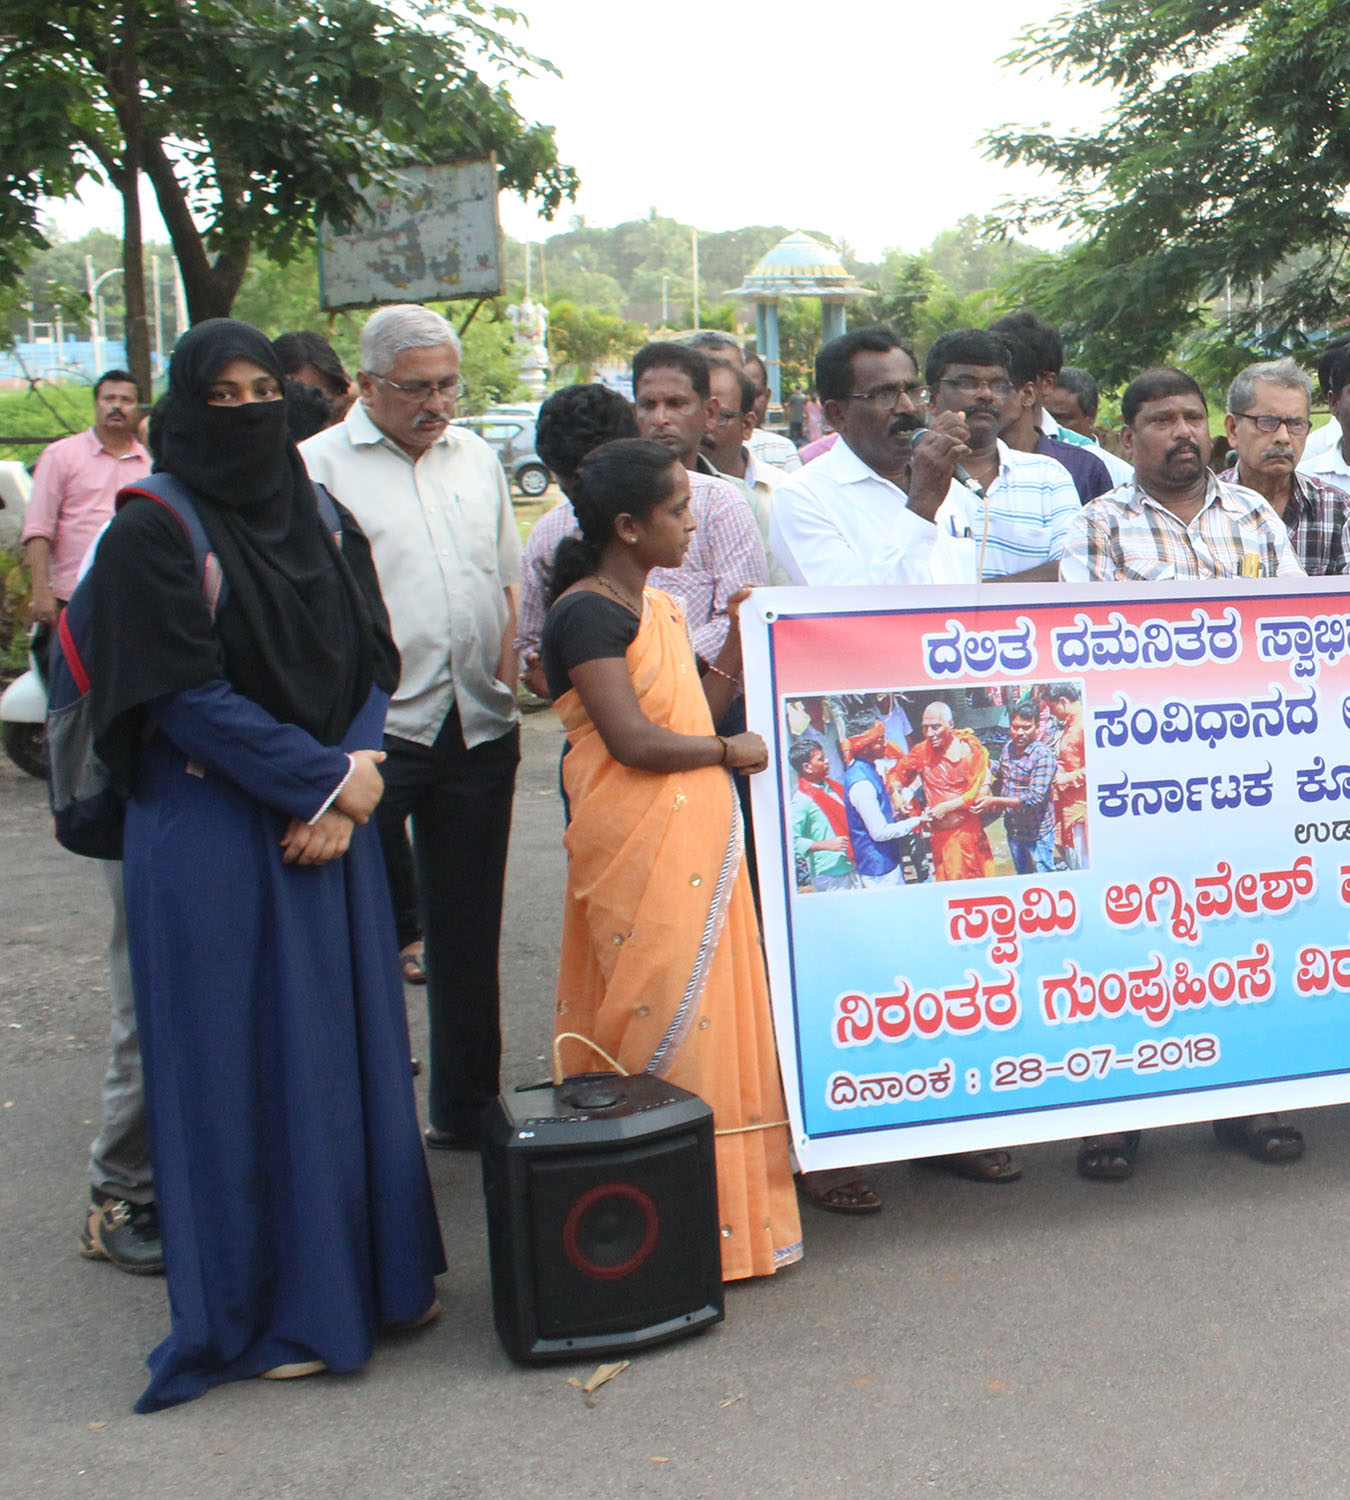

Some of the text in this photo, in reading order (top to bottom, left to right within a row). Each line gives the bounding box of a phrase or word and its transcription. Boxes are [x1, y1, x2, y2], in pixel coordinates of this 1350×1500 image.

[927, 617, 1033, 674] ದಲಿತ
[1056, 608, 1237, 667] ದಮನಿತರ
[1095, 686, 1318, 748] ಸಂವಿಧಾನದ
[1097, 759, 1273, 817] ಕರ್ನಾಟಕ
[949, 887, 1076, 963] ಸ್ವಾಮಿ
[1106, 856, 1313, 940] ಅಗ್ನಿವೇಶ್
[837, 970, 1016, 1042] ನಿರಂತರ
[1043, 943, 1271, 1022] ಗುಂಪುಹಿಂಸೆ
[831, 1063, 951, 1104] ದಿನಾಂಕ
[995, 1036, 1217, 1086] 28-07-2018
